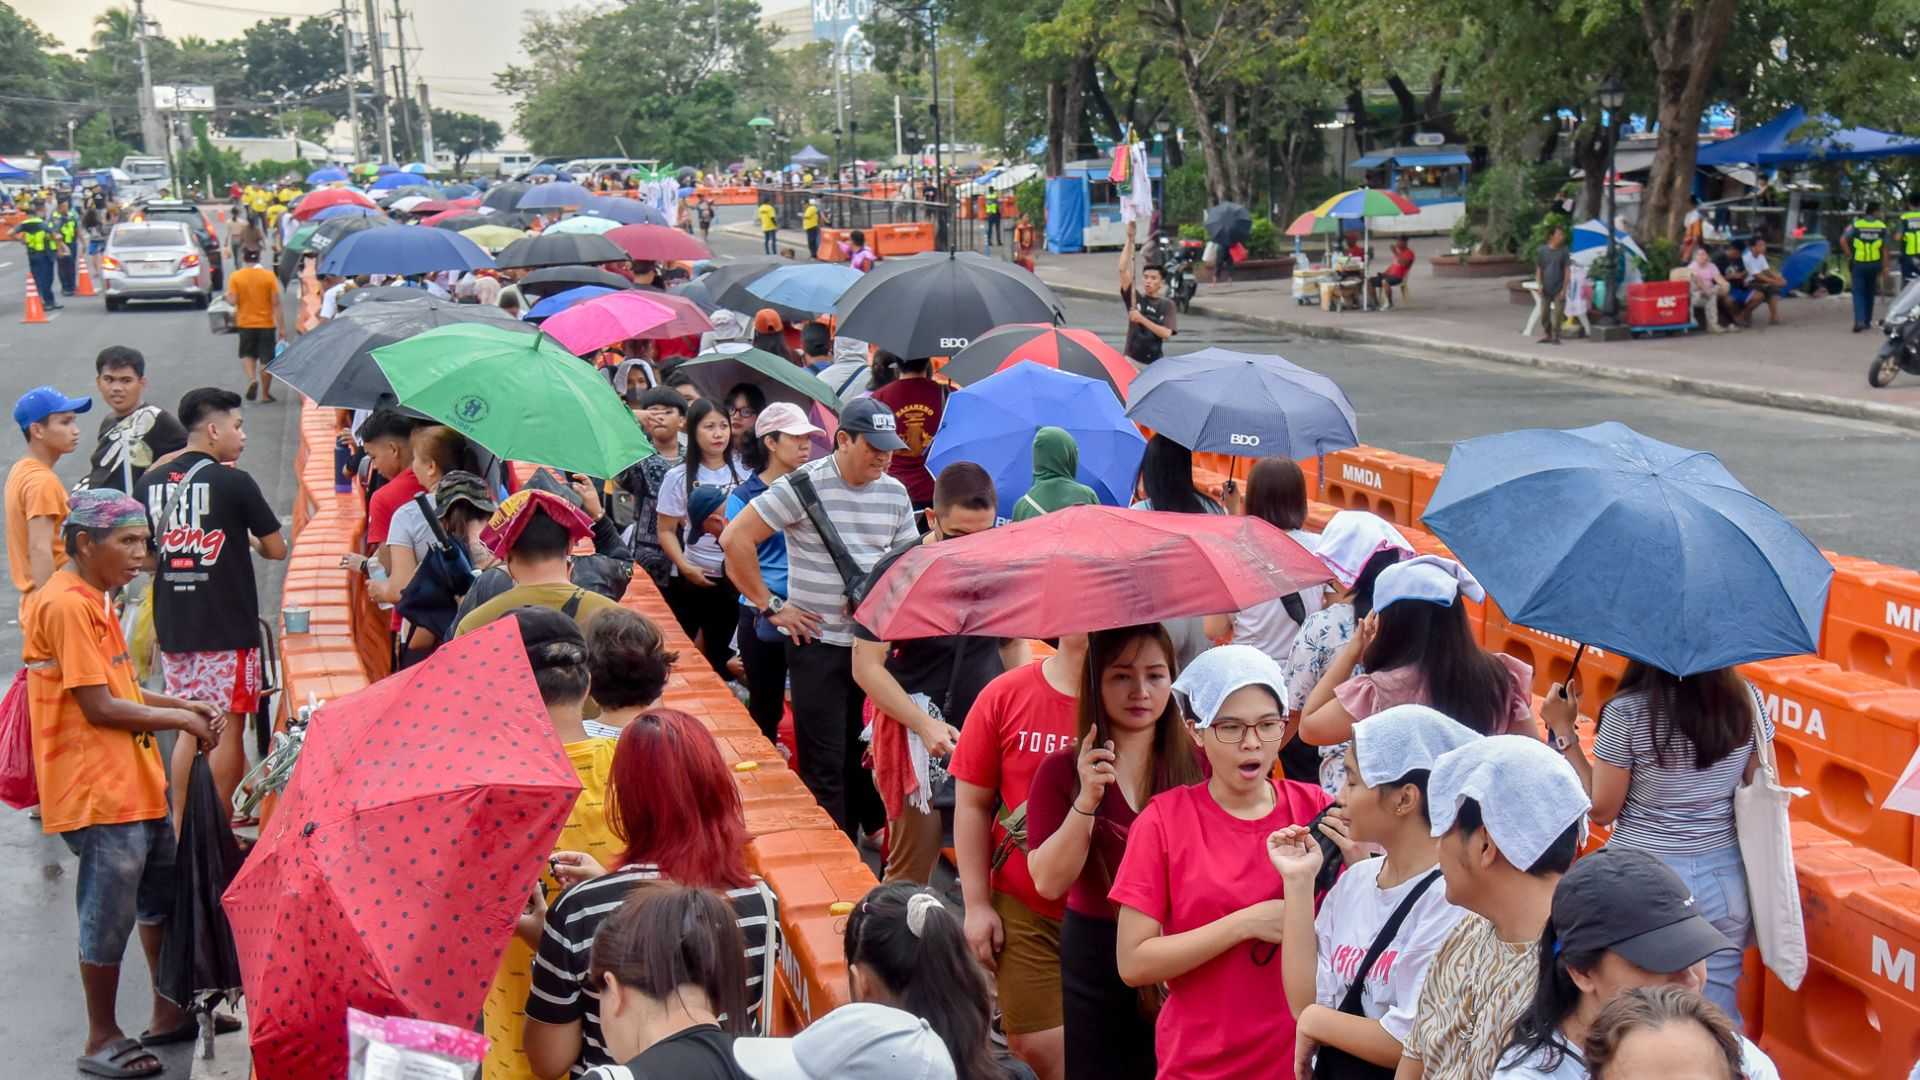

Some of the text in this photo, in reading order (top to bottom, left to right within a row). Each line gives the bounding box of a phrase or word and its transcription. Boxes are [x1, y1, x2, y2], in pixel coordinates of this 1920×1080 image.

[940, 338, 968, 348] BDO
[1231, 434, 1260, 446] BDO
[1343, 463, 1382, 489] MMDA
[1757, 690, 1827, 741] MDA
[1018, 731, 1075, 754] TOGE
